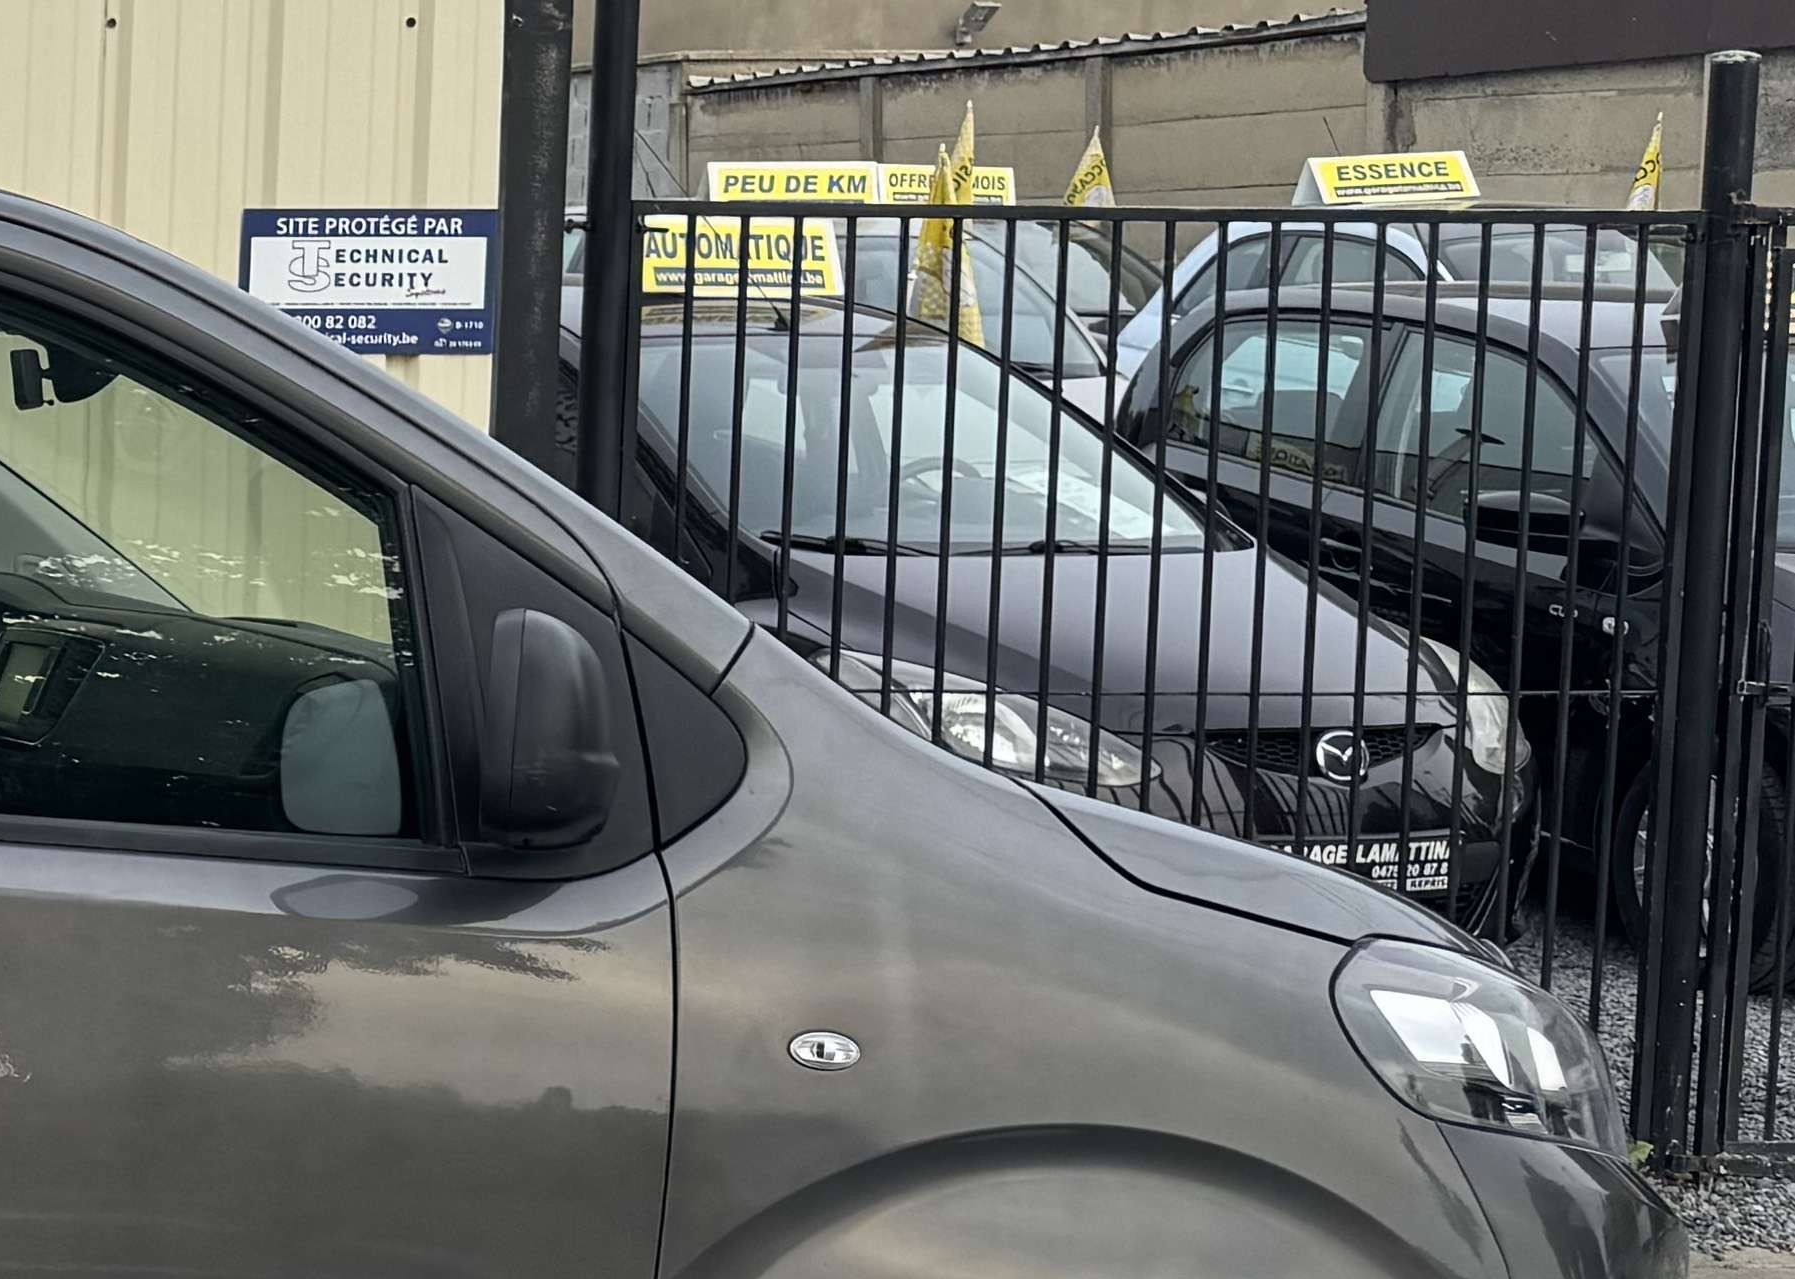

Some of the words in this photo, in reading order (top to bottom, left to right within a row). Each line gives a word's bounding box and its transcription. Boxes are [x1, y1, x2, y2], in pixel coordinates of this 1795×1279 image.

[1336, 160, 1450, 181] ESSENCE
[722, 174, 776, 194] PEU
[784, 174, 819, 194] DE
[827, 174, 867, 194] KM
[276, 217, 319, 235] SITE
[325, 214, 418, 235] PROTÉGÉ
[424, 217, 463, 235] PAR
[325, 314, 344, 329] 82
[348, 314, 377, 329] 082
